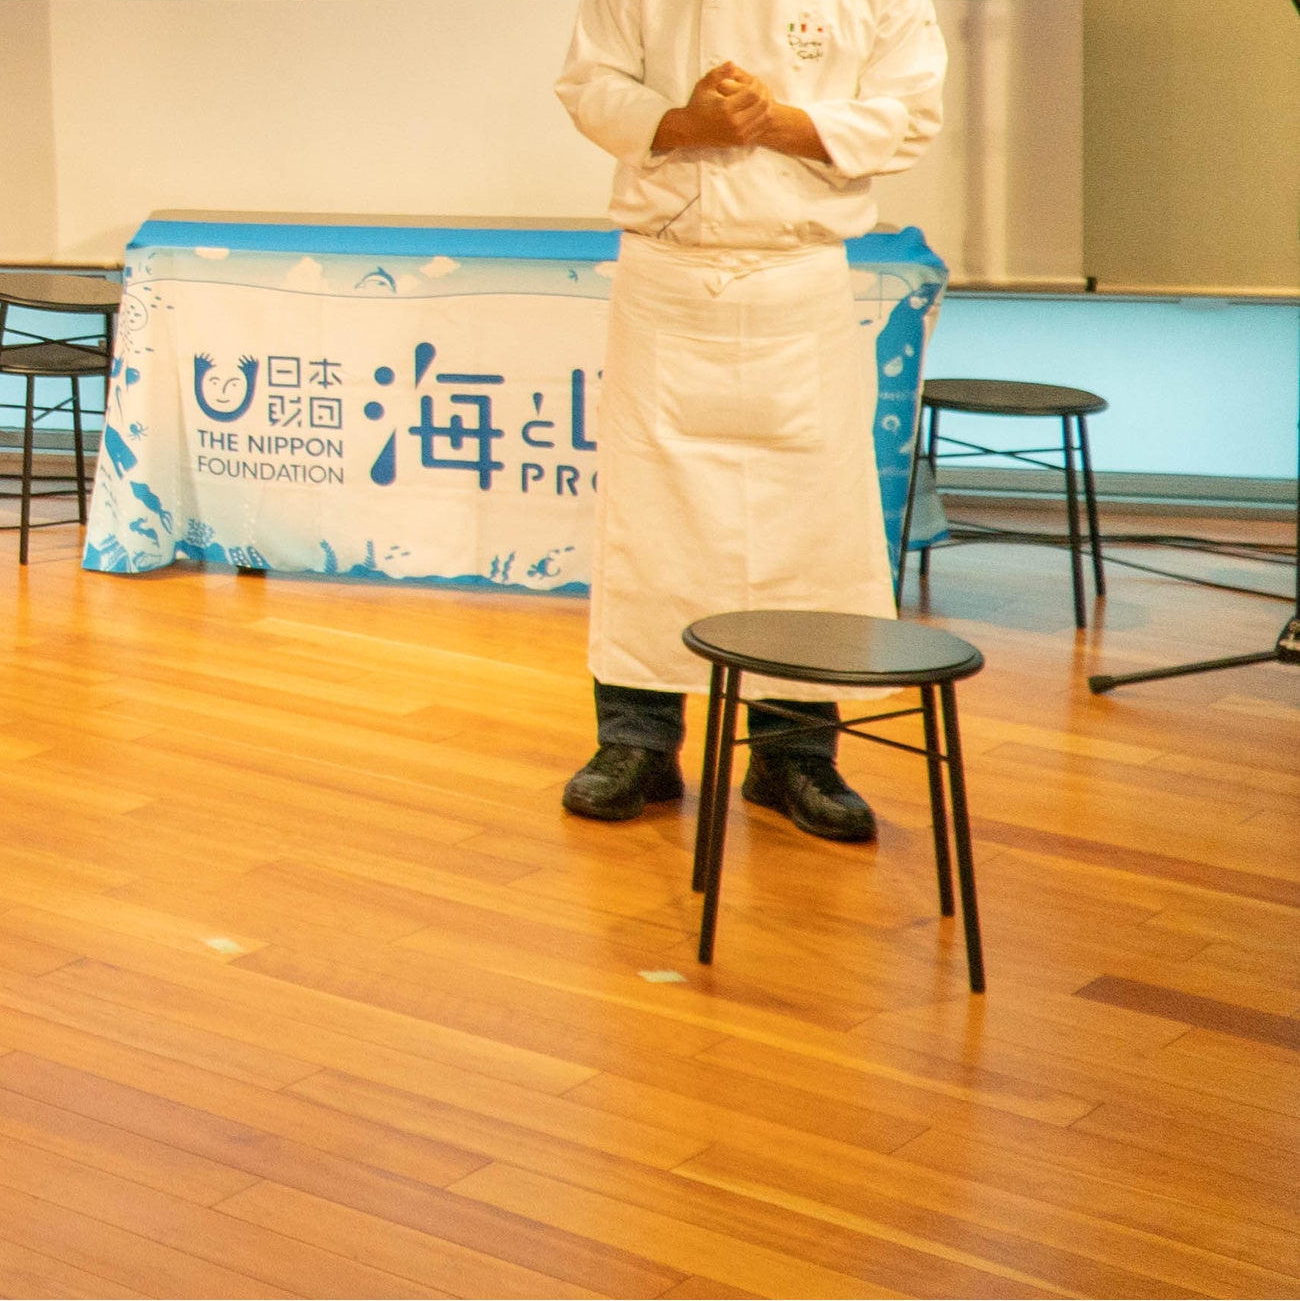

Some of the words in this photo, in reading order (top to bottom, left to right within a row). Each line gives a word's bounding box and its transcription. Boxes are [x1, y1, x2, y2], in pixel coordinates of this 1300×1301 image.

[267, 355, 342, 389] 日本
[267, 394, 343, 430] 財団
[197, 429, 240, 456] THE
[247, 434, 343, 458] NIPPON
[197, 456, 344, 485] FOUNDATION
